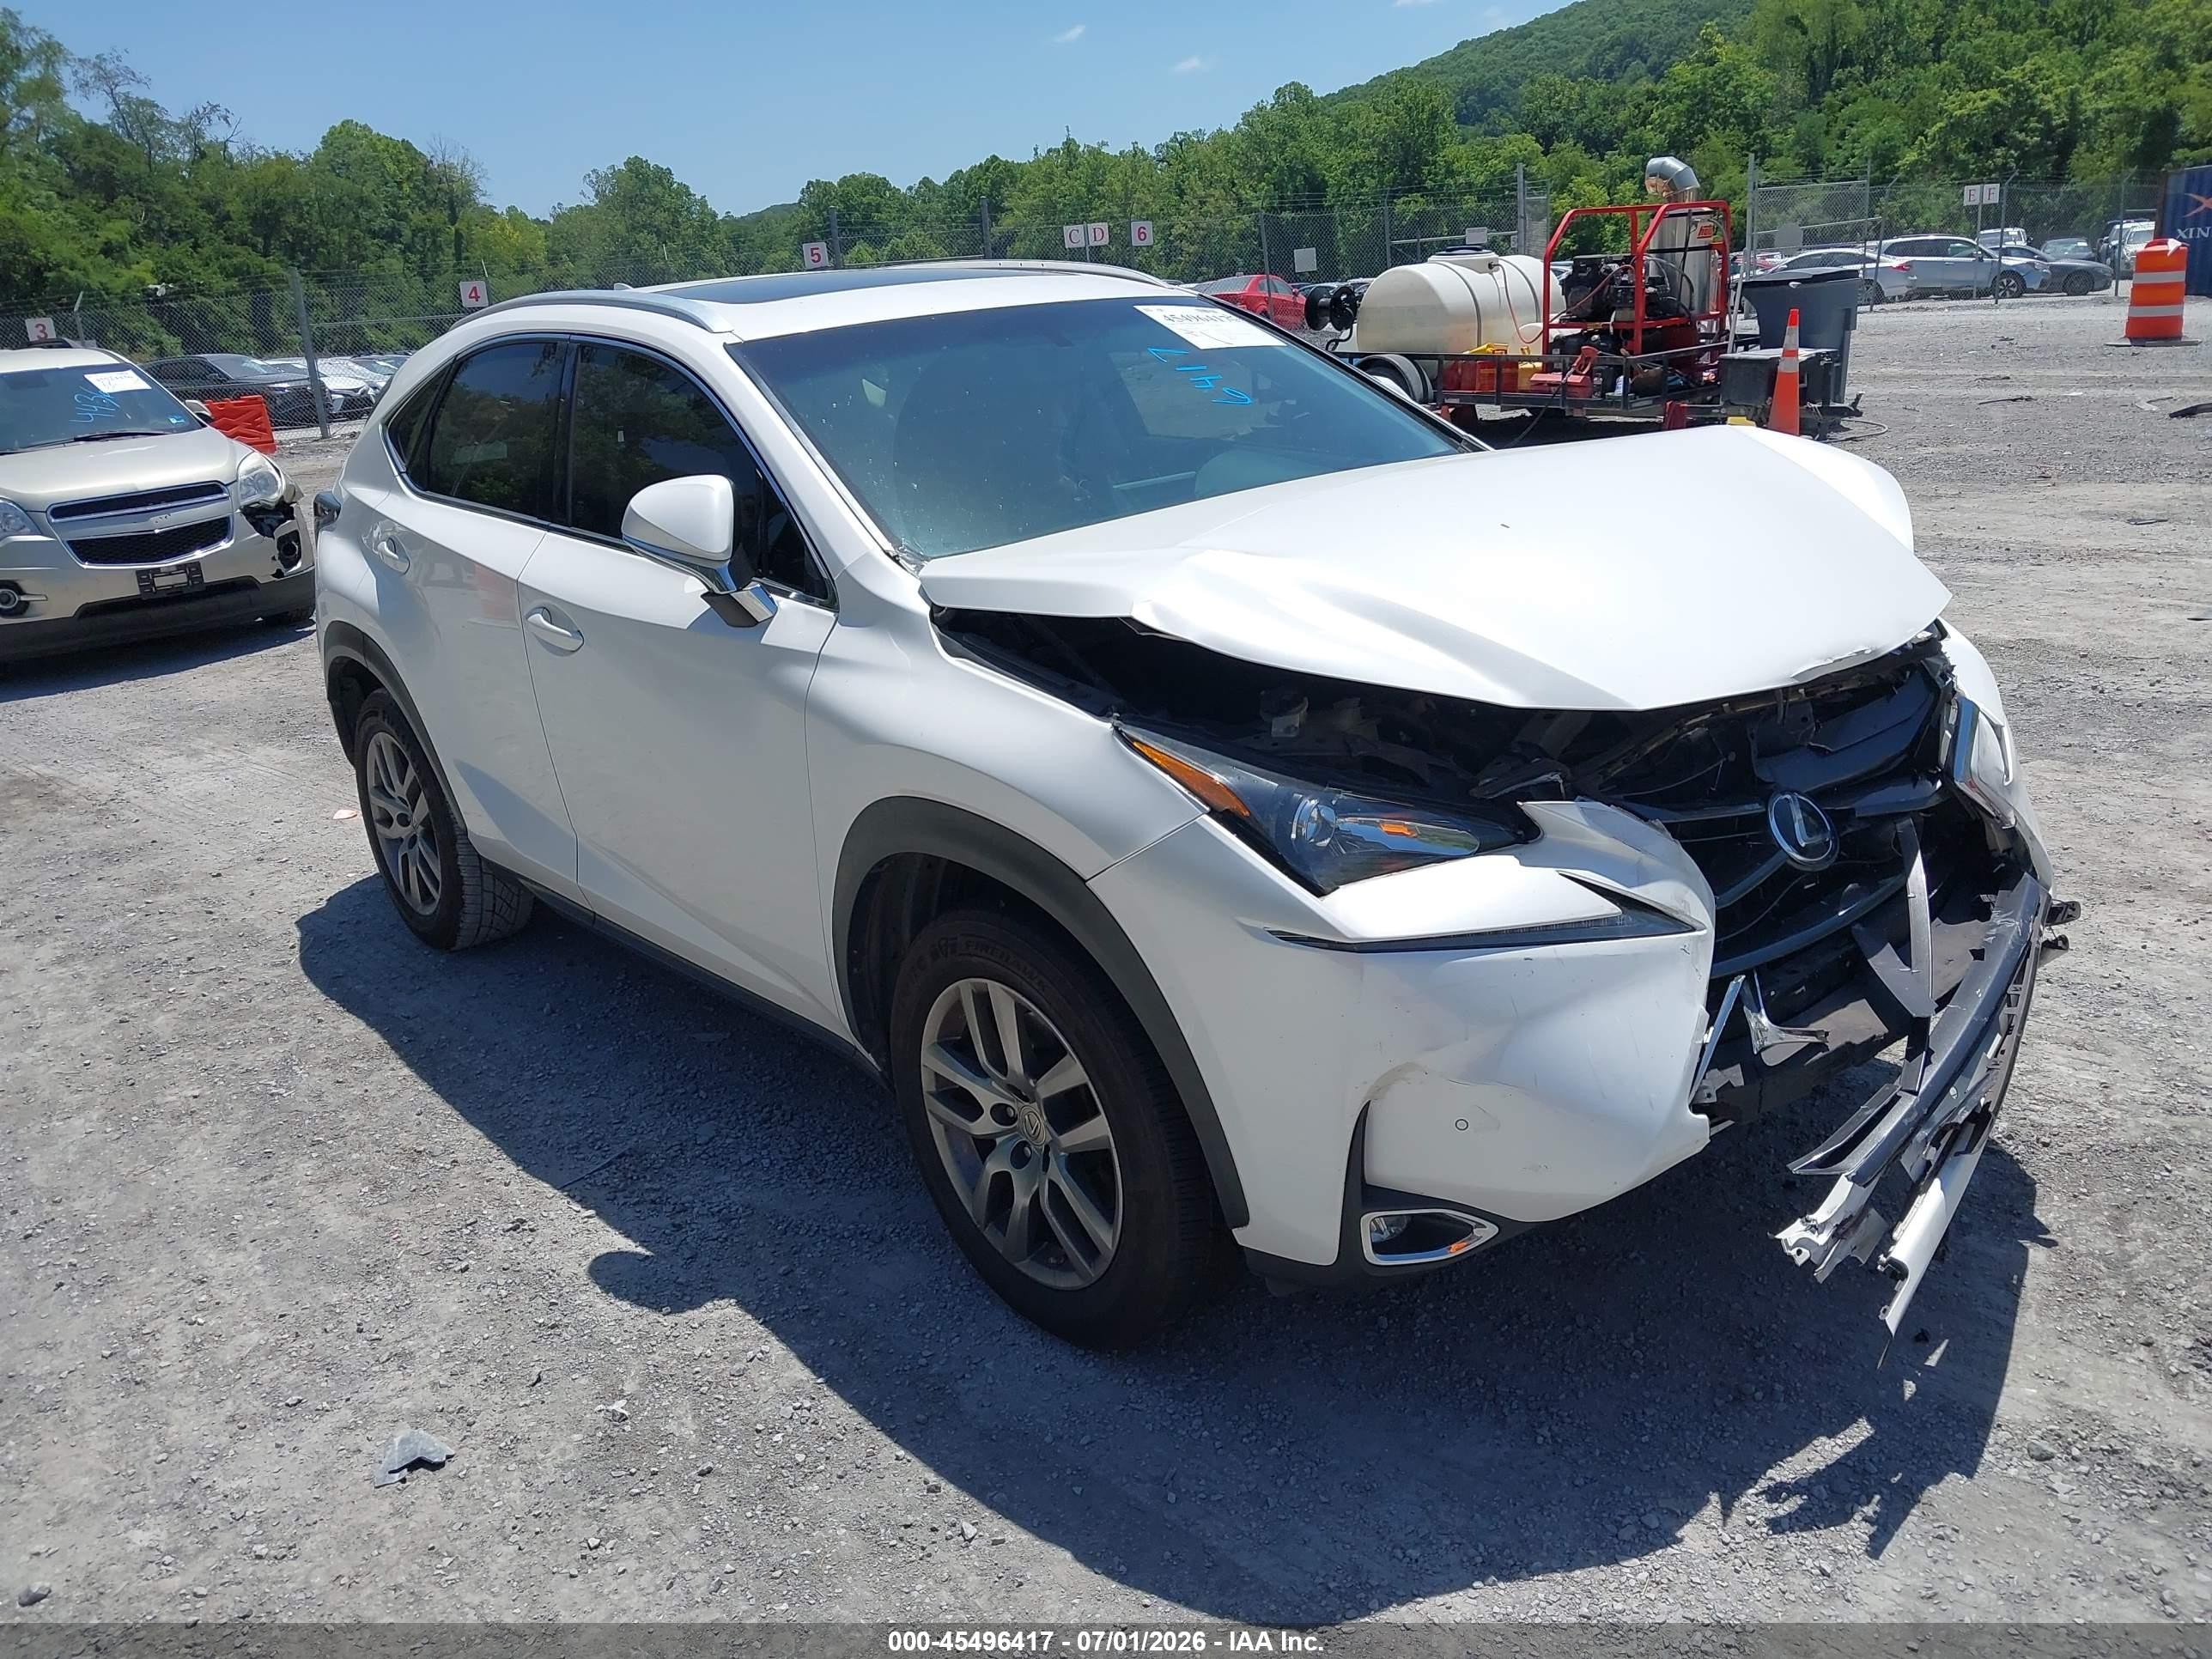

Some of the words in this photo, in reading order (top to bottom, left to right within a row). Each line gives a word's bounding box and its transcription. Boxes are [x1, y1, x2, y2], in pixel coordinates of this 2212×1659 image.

[1968, 189, 1976, 202] E
[1988, 187, 1996, 200] F
[1068, 228, 1080, 244] C
[1092, 227, 1104, 241] D
[1137, 226, 1147, 241] 6
[810, 246, 822, 264] 5
[468, 286, 481, 302] 4
[34, 323, 49, 340] 3
